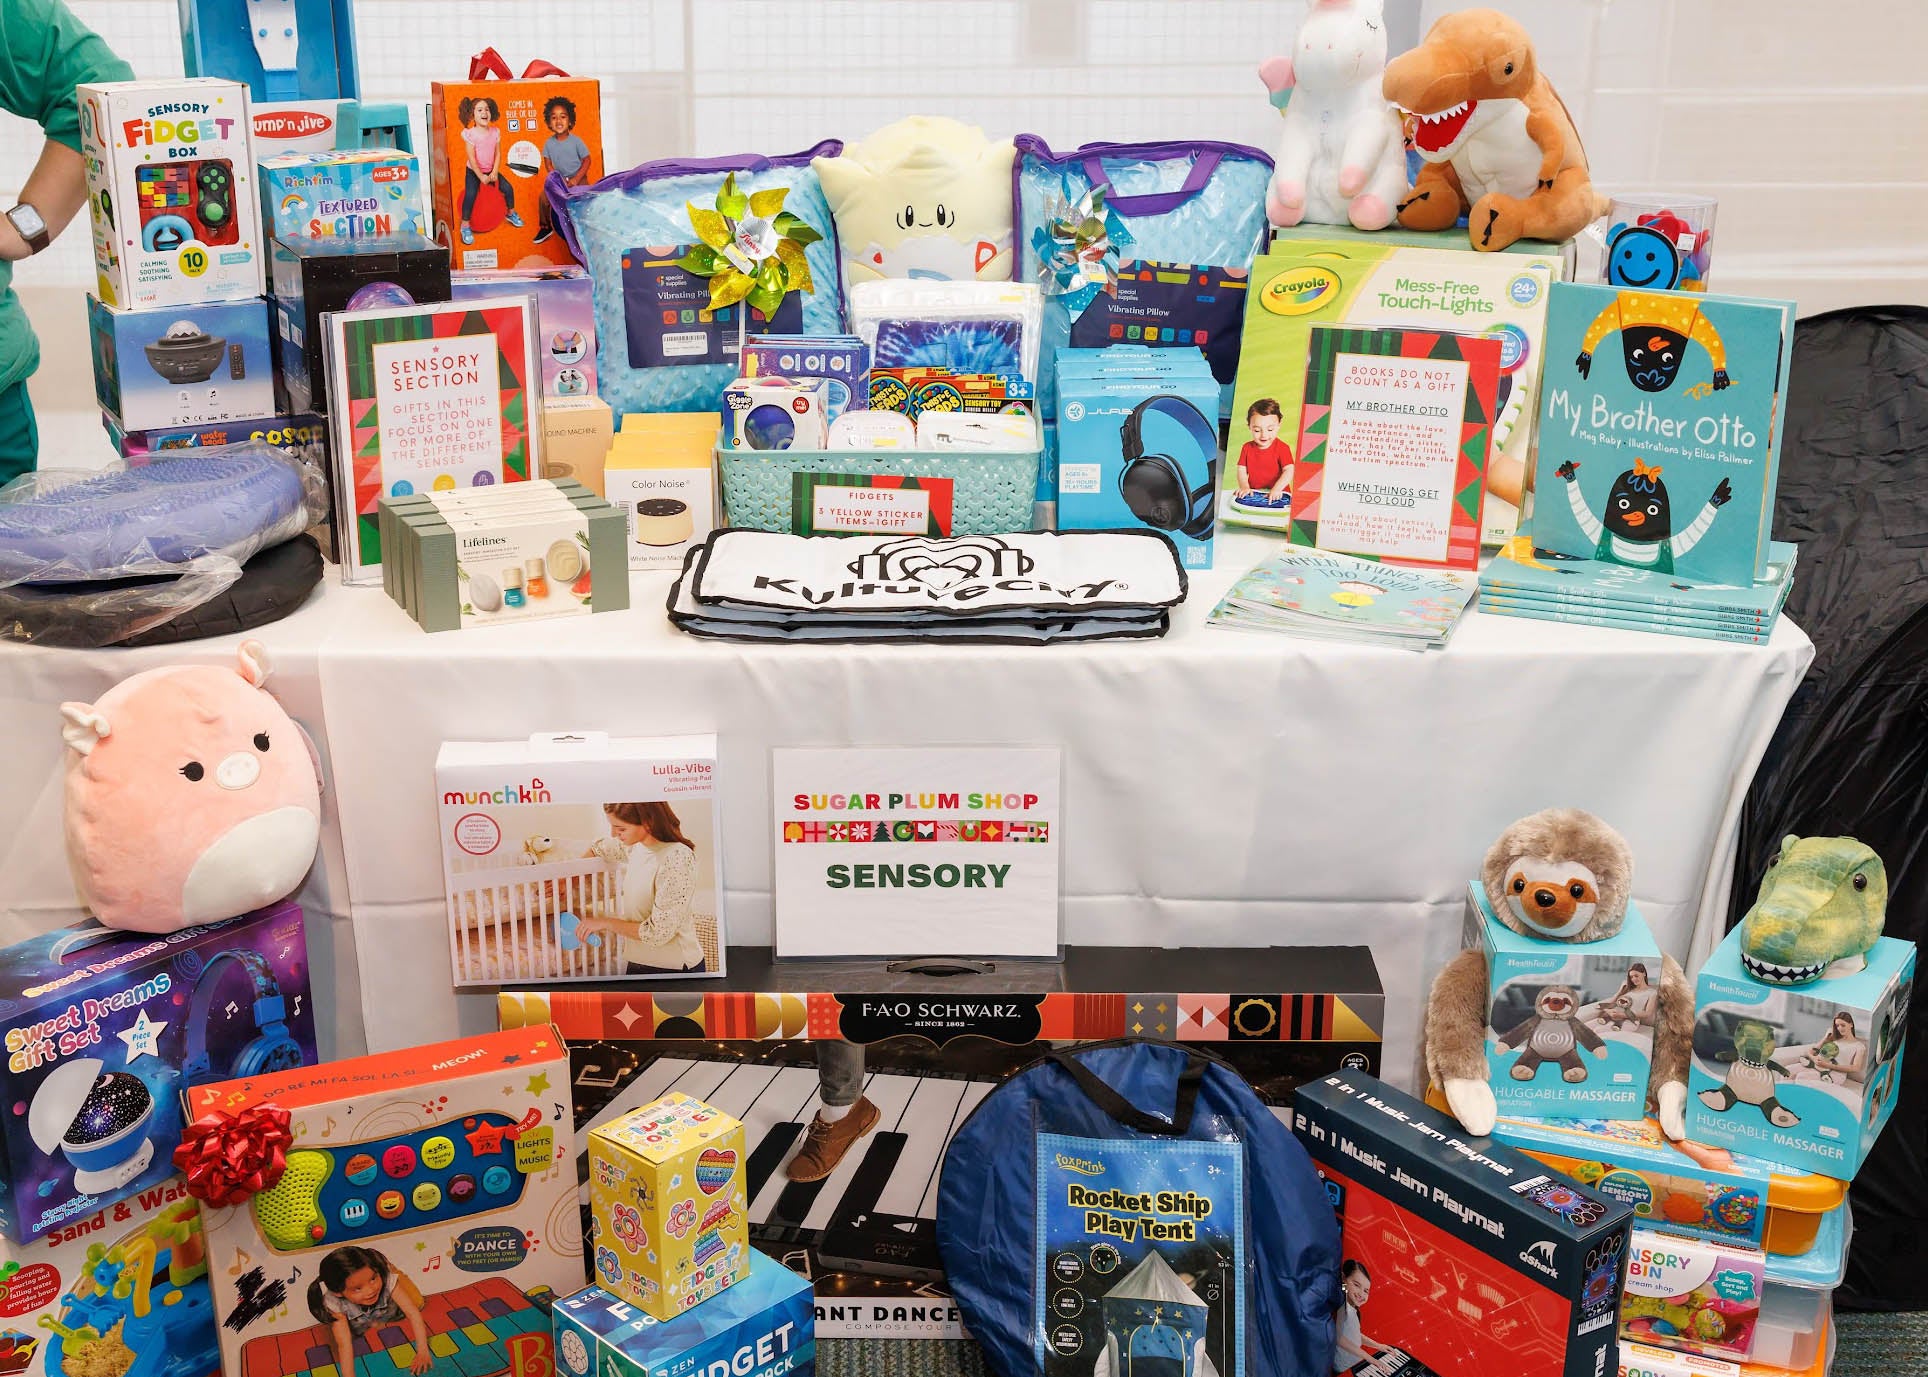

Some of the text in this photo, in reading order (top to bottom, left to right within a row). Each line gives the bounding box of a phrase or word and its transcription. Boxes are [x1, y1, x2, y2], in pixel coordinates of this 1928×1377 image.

[148, 103, 209, 117] SENSORY
[169, 147, 198, 158] BOX
[391, 168, 408, 180] 3+
[140, 260, 168, 268] CALMING
[183, 252, 204, 268] 10
[138, 274, 173, 282] SATISFYING
[1273, 277, 1327, 295] Crayola
[1395, 279, 1480, 295] Mess-Free
[1514, 282, 1537, 293] 24+
[1108, 305, 1170, 317] Vibrating Pillow
[1378, 293, 1494, 315] Touch-Lights
[391, 353, 480, 375] SENSORY
[394, 371, 479, 392] SECTION
[1351, 366, 1451, 381] BOOKS DO NOT
[1008, 382, 1028, 397] 3+
[1344, 376, 1456, 392] COUNT AS A GIFT
[393, 396, 487, 414] GIFTS IN THIS
[1346, 400, 1448, 416] MY BROTHER OTTO
[411, 410, 470, 424] SECTION
[1549, 388, 1756, 448] My Brother Otto
[201, 430, 227, 439] water
[388, 418, 493, 438] FOCUS ON ONE
[202, 437, 227, 446] beads
[399, 430, 484, 448] OR MORE OF
[1580, 430, 1597, 445] Meg
[1599, 434, 1622, 449] Raby
[1682, 448, 1693, 459] by
[1695, 447, 1715, 461] Elisa
[392, 440, 492, 461] THE DIFFERENT
[416, 455, 465, 469] SENSES
[632, 479, 685, 488] Color Noise
[1338, 482, 1439, 499] WHEN THINGS GET
[849, 492, 894, 500] FIDGETS
[1359, 494, 1415, 507] TOO LOUD
[830, 508, 872, 517] YELLOW
[878, 510, 923, 519] STICKER
[463, 536, 506, 548] Lifelines
[1280, 556, 1340, 570] WHEN
[1352, 562, 1421, 582] THINGS
[1316, 569, 1422, 592] TOO LOUD
[652, 764, 712, 776] Lulla-Vibe
[668, 776, 698, 784] Vibrating
[689, 784, 712, 792] vibrant
[444, 784, 551, 805] munchkin
[794, 793, 1038, 810] SUGAR PLUM SHOP
[826, 864, 1011, 888] SENSORY
[86, 942, 168, 974] Dreams
[22, 969, 92, 998] Sweet
[5, 973, 172, 1052] Sweet Dreams
[138, 1020, 145, 1031] 2
[9, 1021, 102, 1073] Gift Set
[136, 1042, 147, 1050] Set
[264, 1048, 488, 1099] DO RE MI FA SOL LA MEOW!
[1495, 1087, 1636, 1103] HUGGABLE MASSAGER
[1325, 1077, 1341, 1086] 2
[1338, 1083, 1356, 1094] in
[1364, 1096, 1410, 1122] Music
[1408, 1118, 1447, 1142] Jam
[1446, 1138, 1514, 1177] Playmat
[517, 1137, 551, 1149] LIGHTS
[1697, 1112, 1769, 1140] HUGGABLE
[1773, 1133, 1844, 1160] MASSAGER
[519, 1154, 550, 1166] MUSIC
[1055, 1152, 1106, 1173] foxprint
[593, 1156, 627, 1182] FIDGET
[1208, 1165, 1221, 1175] 3+
[1296, 1113, 1505, 1239] 2 in 1 Music Jam Playmat
[1601, 1187, 1649, 1200] SENSORY
[1615, 1194, 1633, 1204] BIN
[1068, 1184, 1213, 1221] Rocket Ship
[47, 1181, 188, 1248] Sand & Wat
[1085, 1210, 1196, 1243] Play Tent
[464, 1239, 517, 1253] DANCE
[1519, 1251, 1560, 1279] QShark
[1630, 1263, 1662, 1279] BIN
[681, 1253, 736, 1294] FIDGET
[9, 1272, 51, 1292] pouring and
[1628, 1279, 1675, 1293] cream shop
[7, 1287, 57, 1310] provides hours
[9, 1281, 52, 1300] falling water
[677, 1270, 738, 1311] TOYS SET
[22, 1299, 45, 1311] of fun!
[814, 1306, 959, 1321] ANT DANCE
[671, 1357, 696, 1377] ZEN
